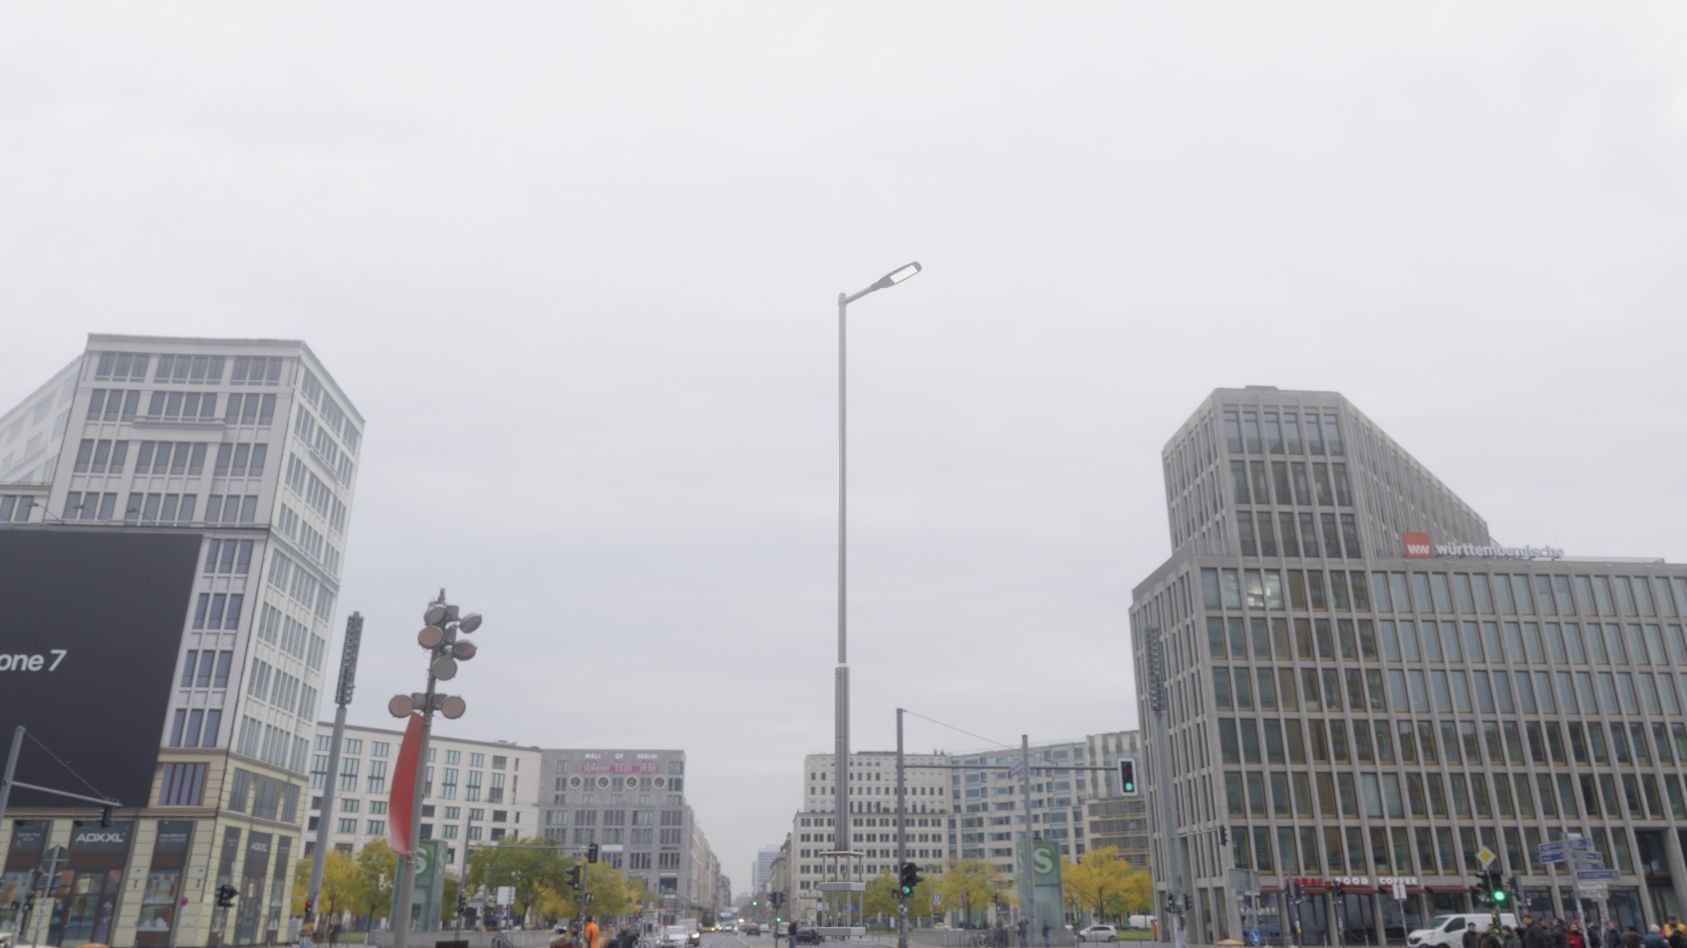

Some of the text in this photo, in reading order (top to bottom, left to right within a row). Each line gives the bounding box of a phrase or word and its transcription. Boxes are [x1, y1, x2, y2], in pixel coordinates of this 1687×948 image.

[48, 648, 67, 671] 7
[584, 752, 658, 760] MALL OF BERLIN
[1034, 847, 1053, 874] S
[1379, 877, 1419, 885] COFFEE
